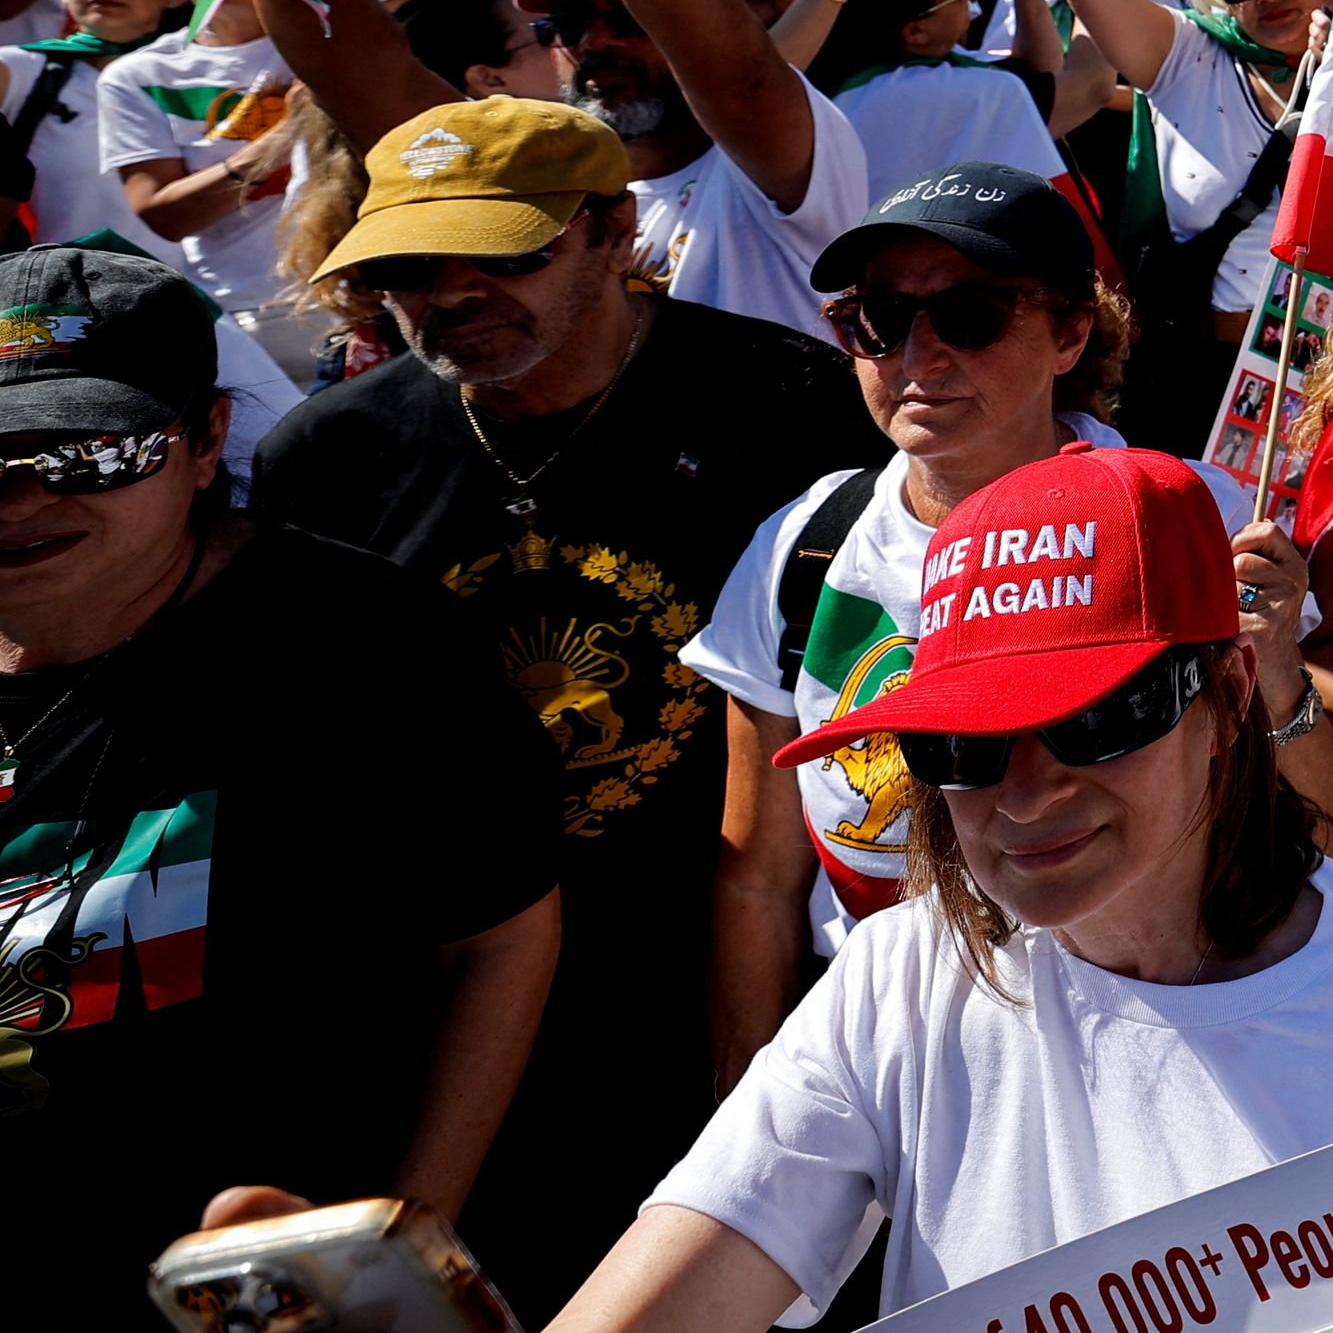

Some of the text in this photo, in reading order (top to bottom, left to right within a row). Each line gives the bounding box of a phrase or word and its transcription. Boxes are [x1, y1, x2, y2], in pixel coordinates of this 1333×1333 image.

[975, 187, 1007, 202] زن
[981, 521, 1098, 570] IRAN
[963, 574, 1094, 622] AGAIN
